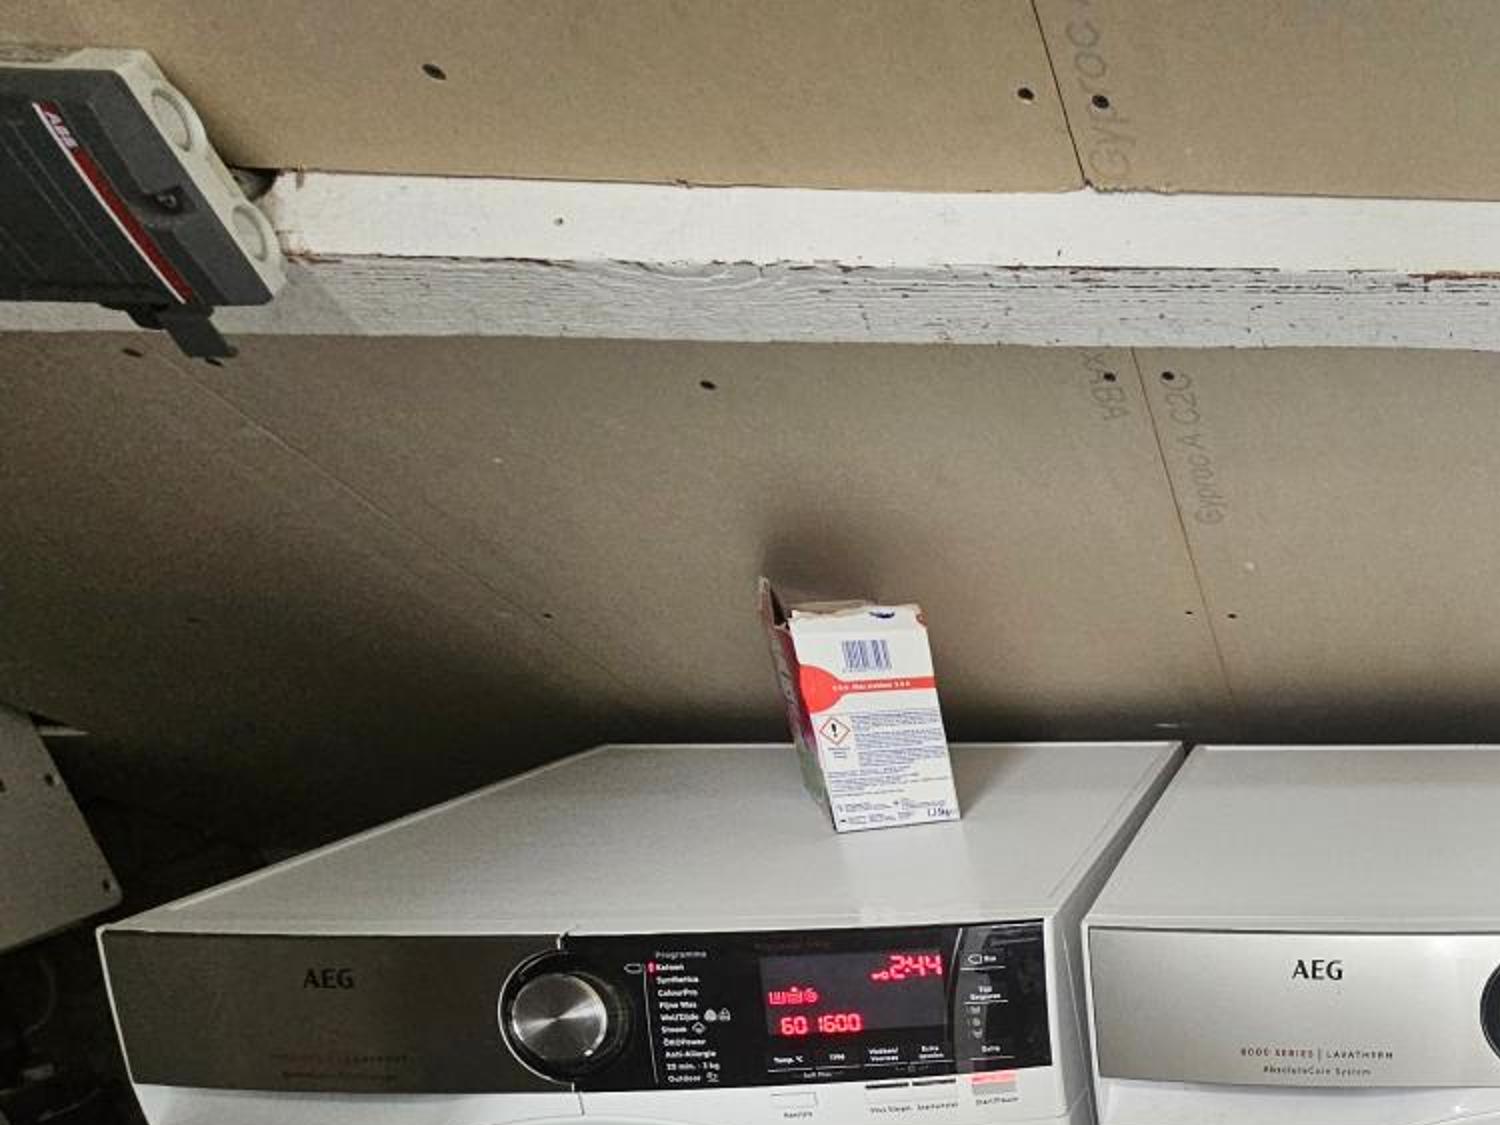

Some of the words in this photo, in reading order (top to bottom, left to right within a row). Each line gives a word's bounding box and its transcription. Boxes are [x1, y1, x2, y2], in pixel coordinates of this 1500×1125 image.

[303, 967, 355, 989] AEG
[1291, 959, 1344, 981] AEG
[780, 1016, 808, 1035] 60
[818, 1013, 863, 1032] 1600
[1241, 1047, 1269, 1057] 8000
[1325, 1049, 1393, 1059] LAVATHERM
[1335, 1066, 1372, 1078] System
